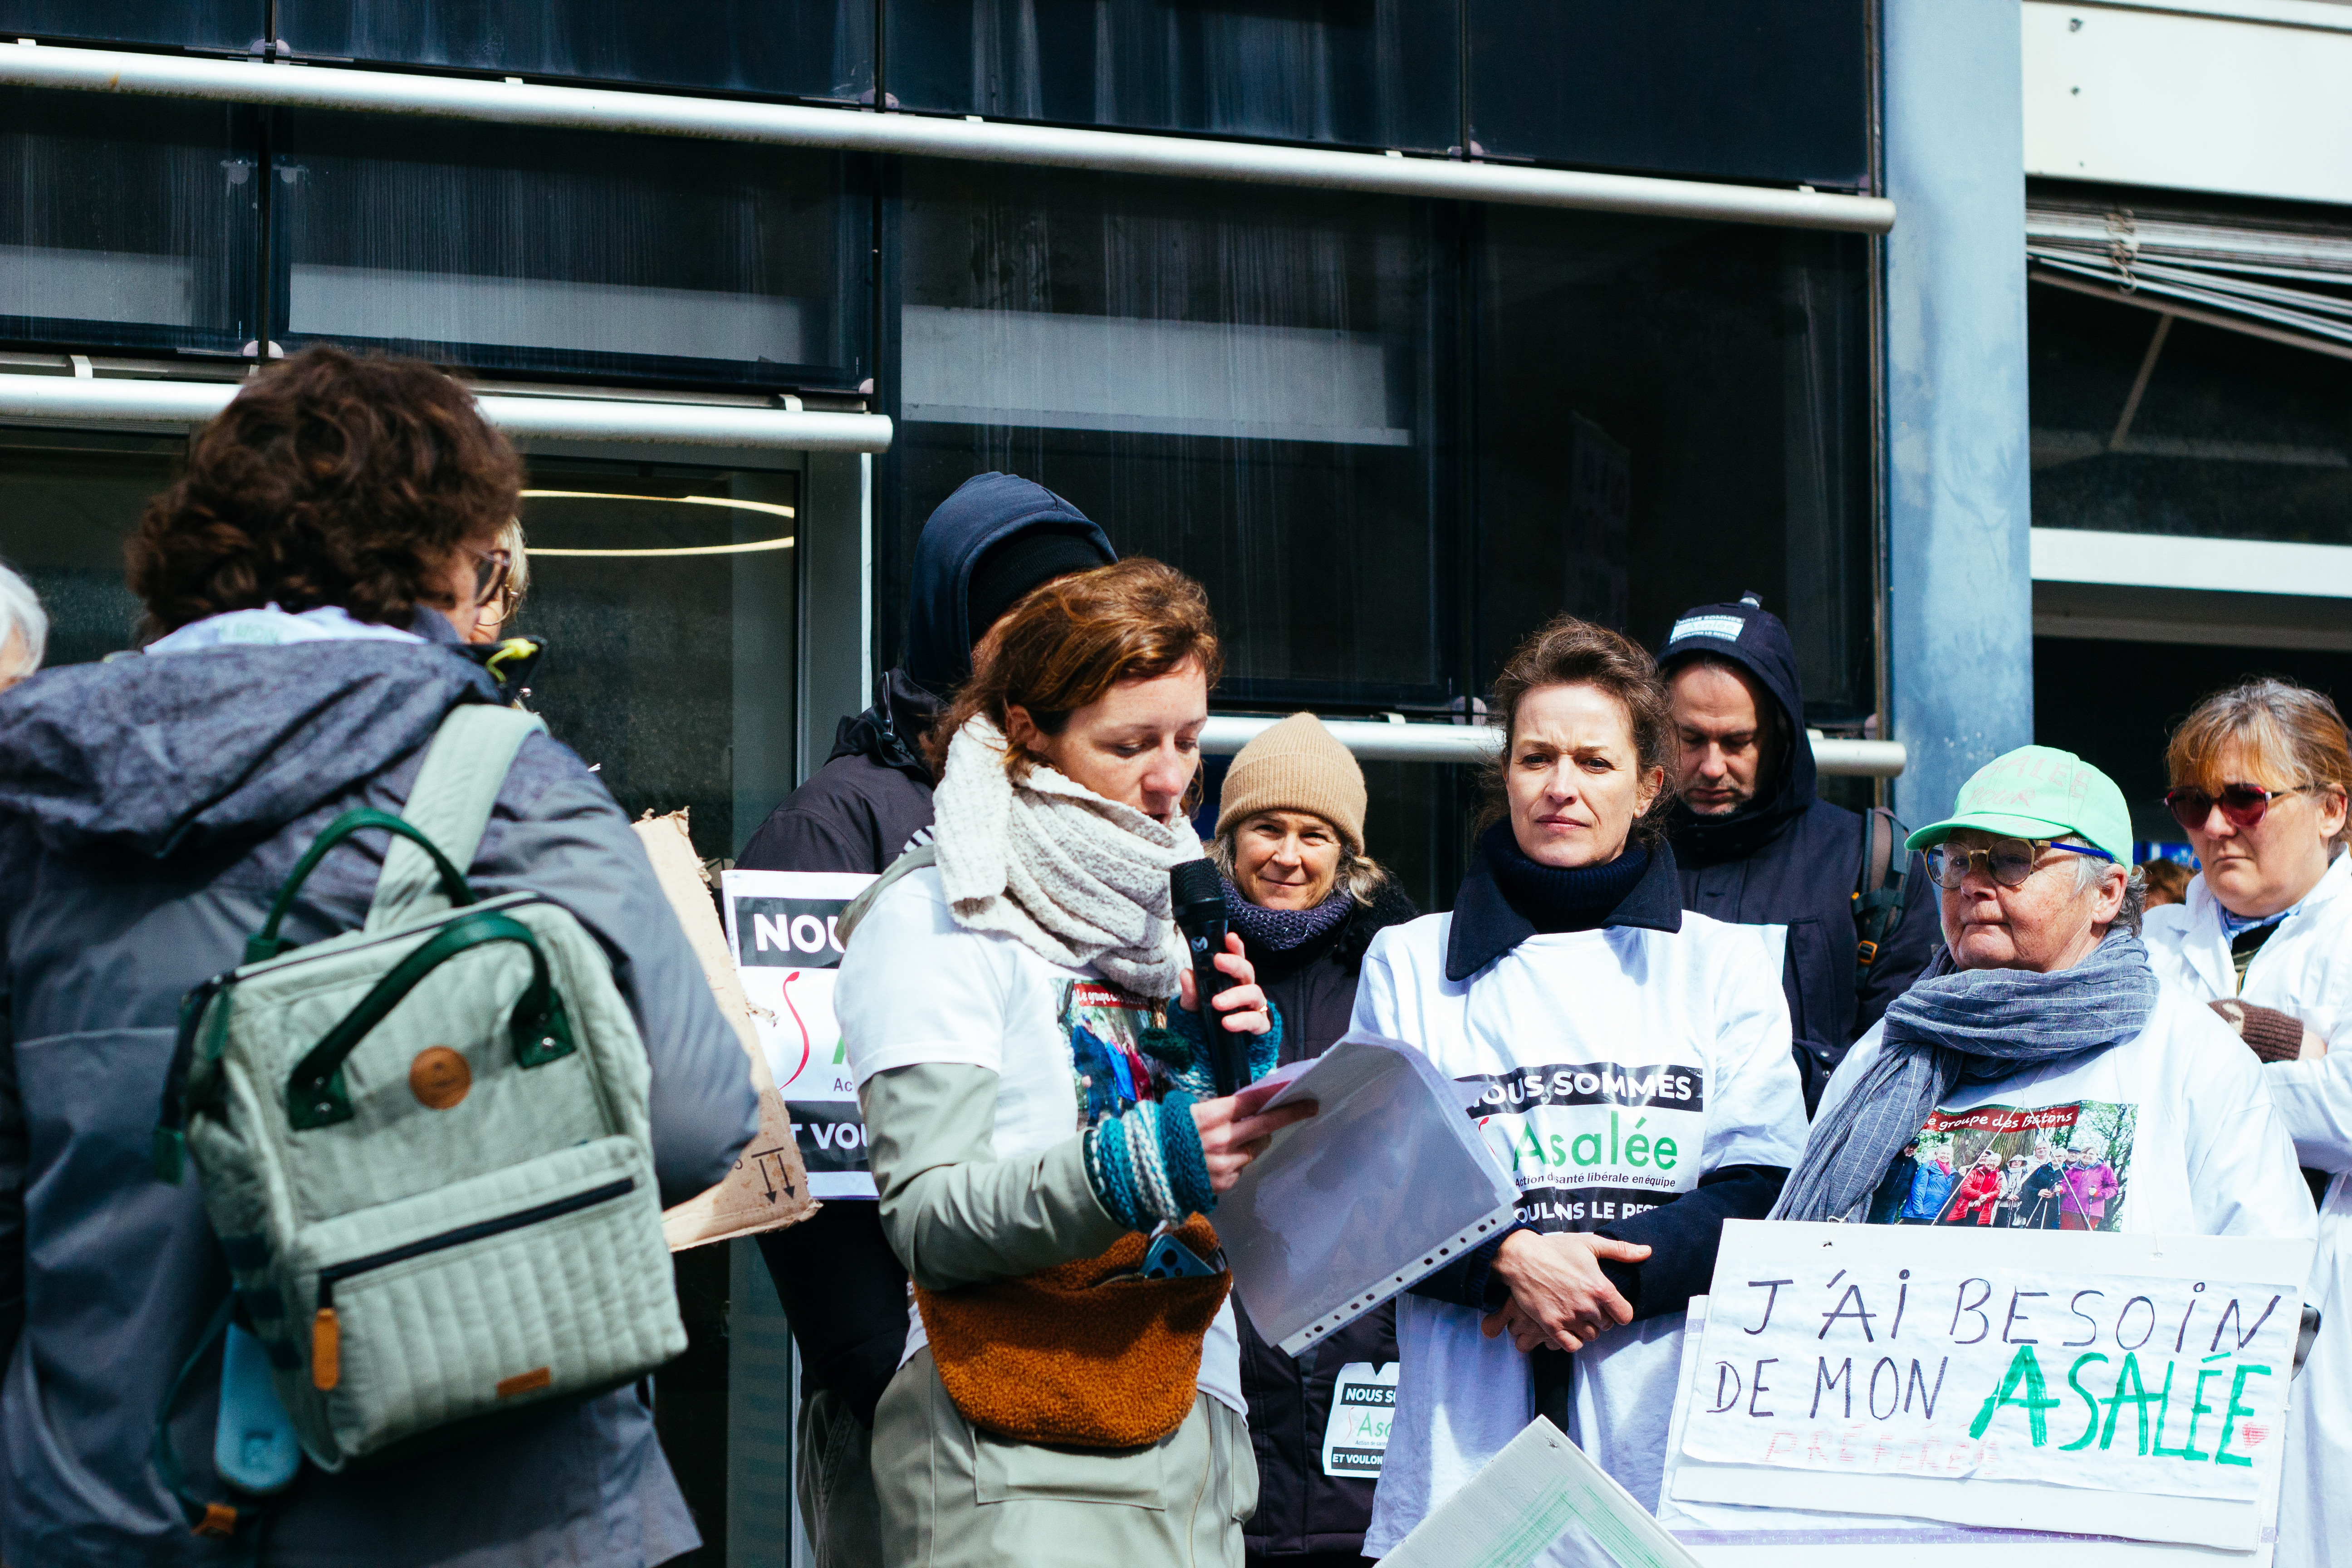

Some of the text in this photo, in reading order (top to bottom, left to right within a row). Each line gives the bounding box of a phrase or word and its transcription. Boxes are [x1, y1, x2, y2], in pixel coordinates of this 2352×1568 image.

[1704, 615, 1742, 623] SOMMES
[1963, 787, 2036, 811] POUR
[1473, 1071, 1692, 1107] OUS SOMMES
[1939, 1114, 1989, 1131] groupe
[1992, 1114, 2019, 1128] des
[810, 1122, 868, 1150] VO
[1512, 1111, 1677, 1171] Asalée
[1516, 1174, 1544, 1187] Action
[1556, 1172, 1584, 1184] santé
[1588, 1171, 1629, 1182] libérale
[1645, 1174, 1676, 1188] équipe
[1592, 1201, 1615, 1220] LE
[1345, 1388, 1383, 1402] NOUS
[1706, 1359, 1779, 1419] DE
[1809, 1356, 1949, 1421] MON
[1333, 1453, 1345, 1463] ET
